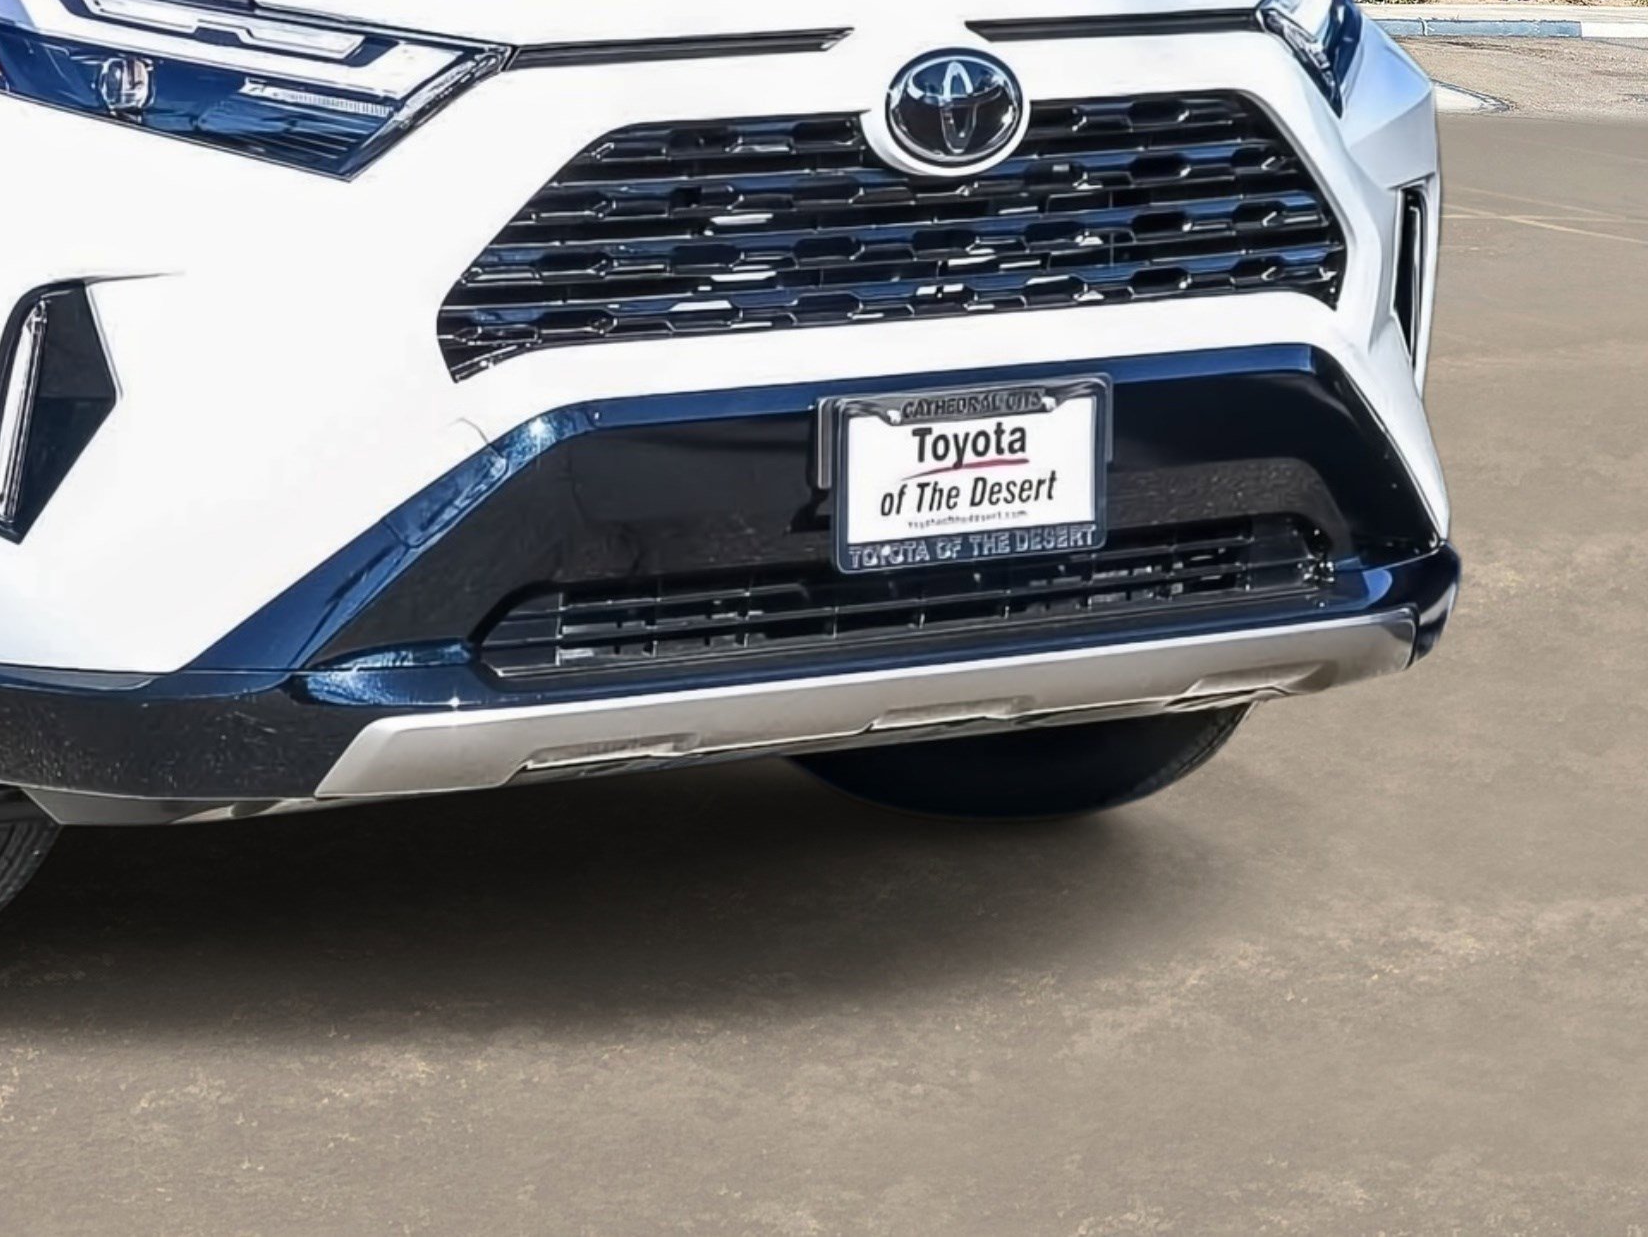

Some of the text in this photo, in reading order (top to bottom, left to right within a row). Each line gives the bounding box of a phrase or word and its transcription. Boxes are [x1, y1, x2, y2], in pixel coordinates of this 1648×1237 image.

[912, 422, 1026, 468] Toyota
[881, 470, 1056, 517] of The Desert
[848, 523, 1097, 570] TOYOTA OF THE DESERT
